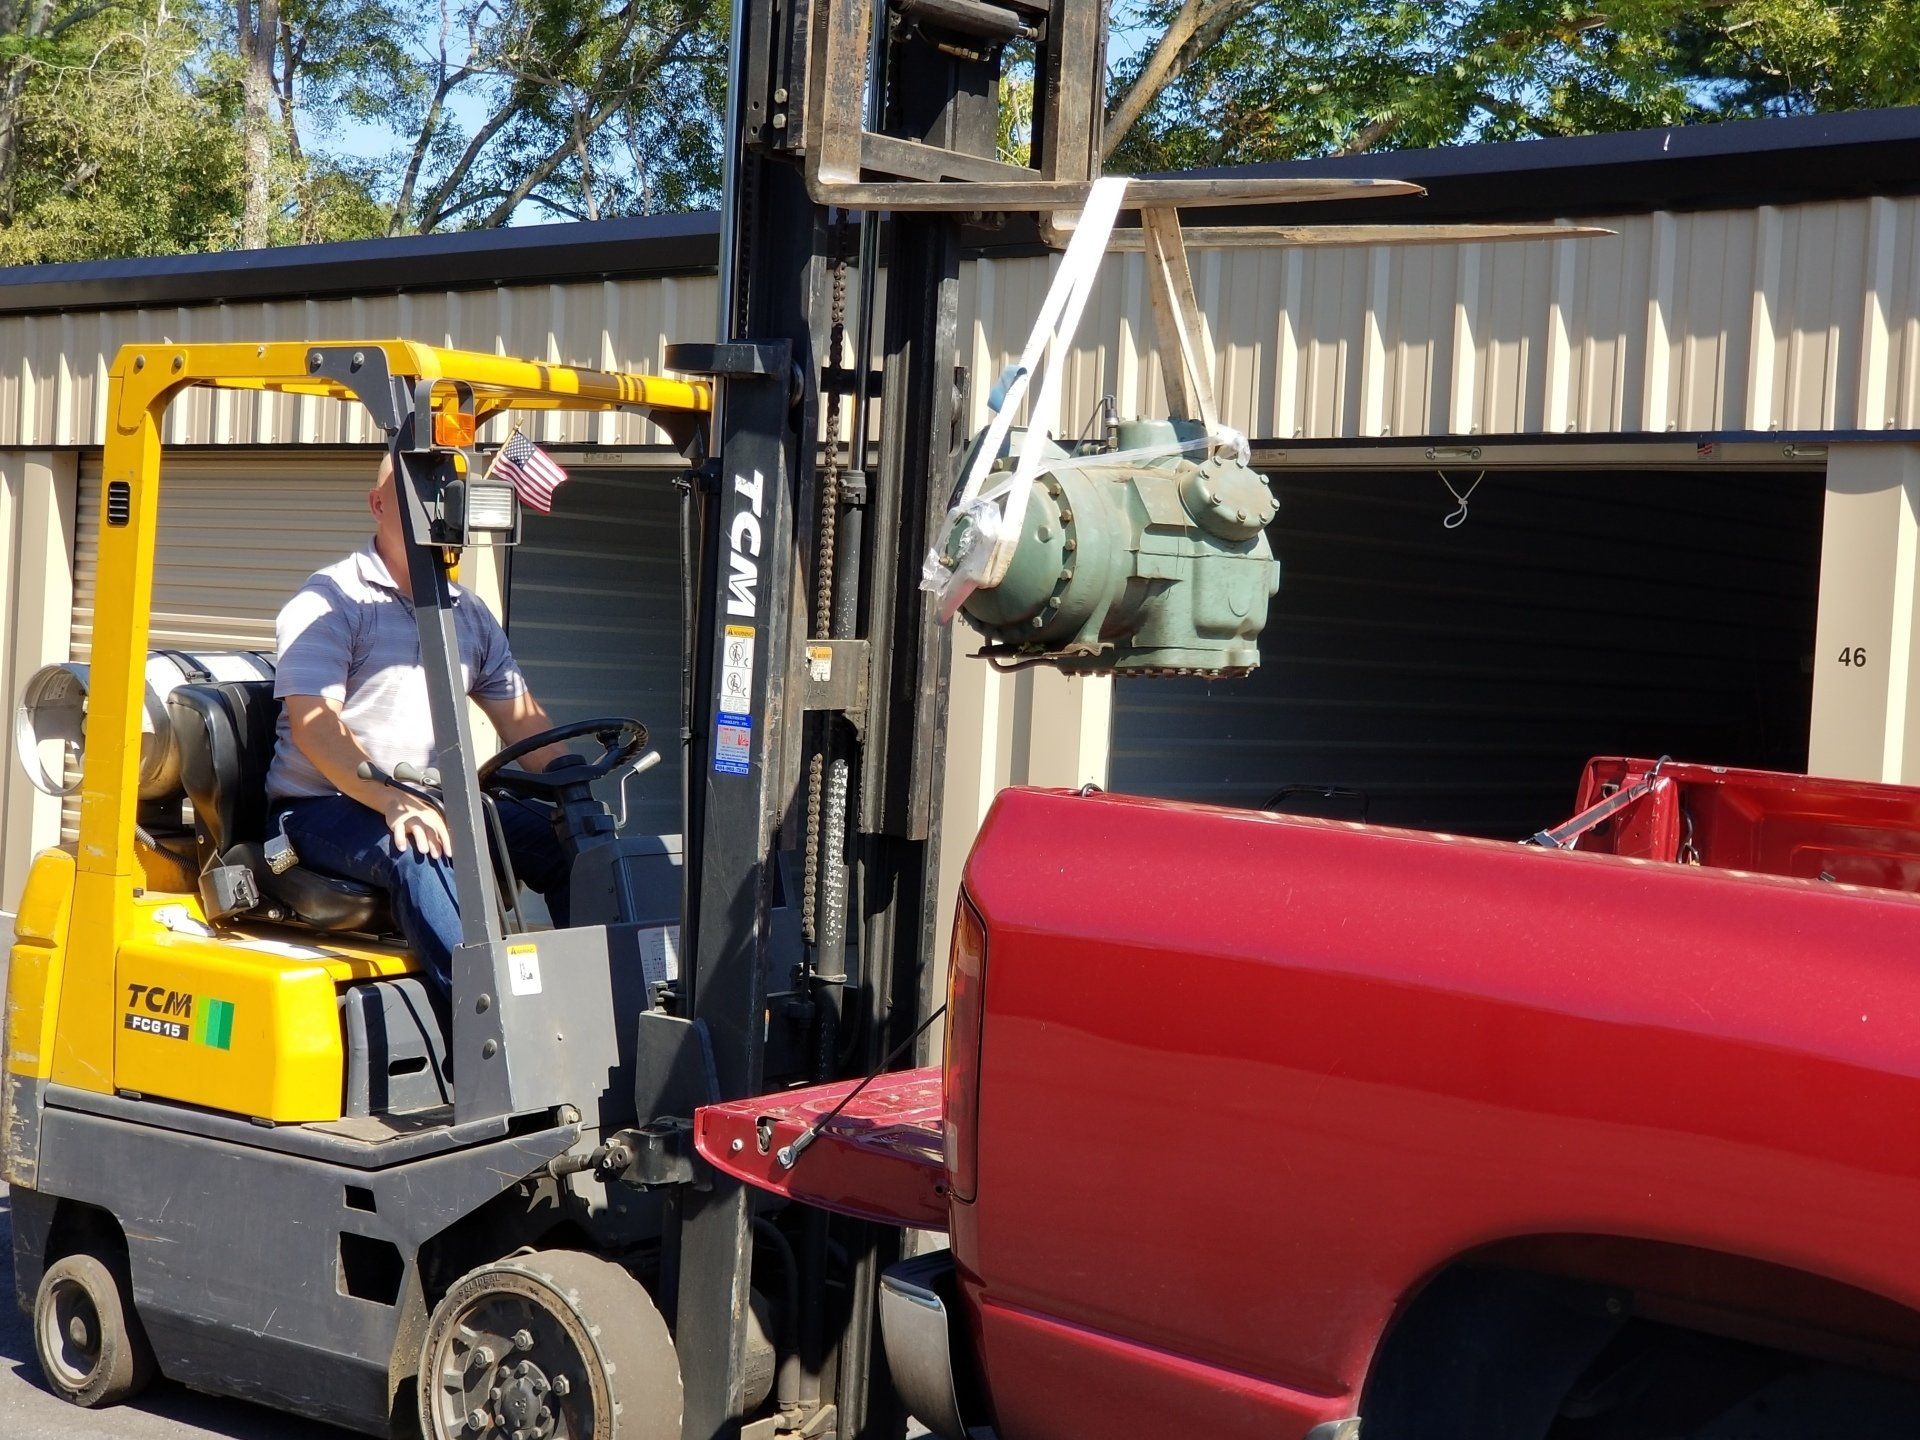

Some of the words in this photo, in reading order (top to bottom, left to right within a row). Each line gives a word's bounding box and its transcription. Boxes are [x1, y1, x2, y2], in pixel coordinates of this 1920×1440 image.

[727, 469, 764, 617] TCM
[1838, 647, 1867, 667] 46
[128, 983, 193, 1018] TCM
